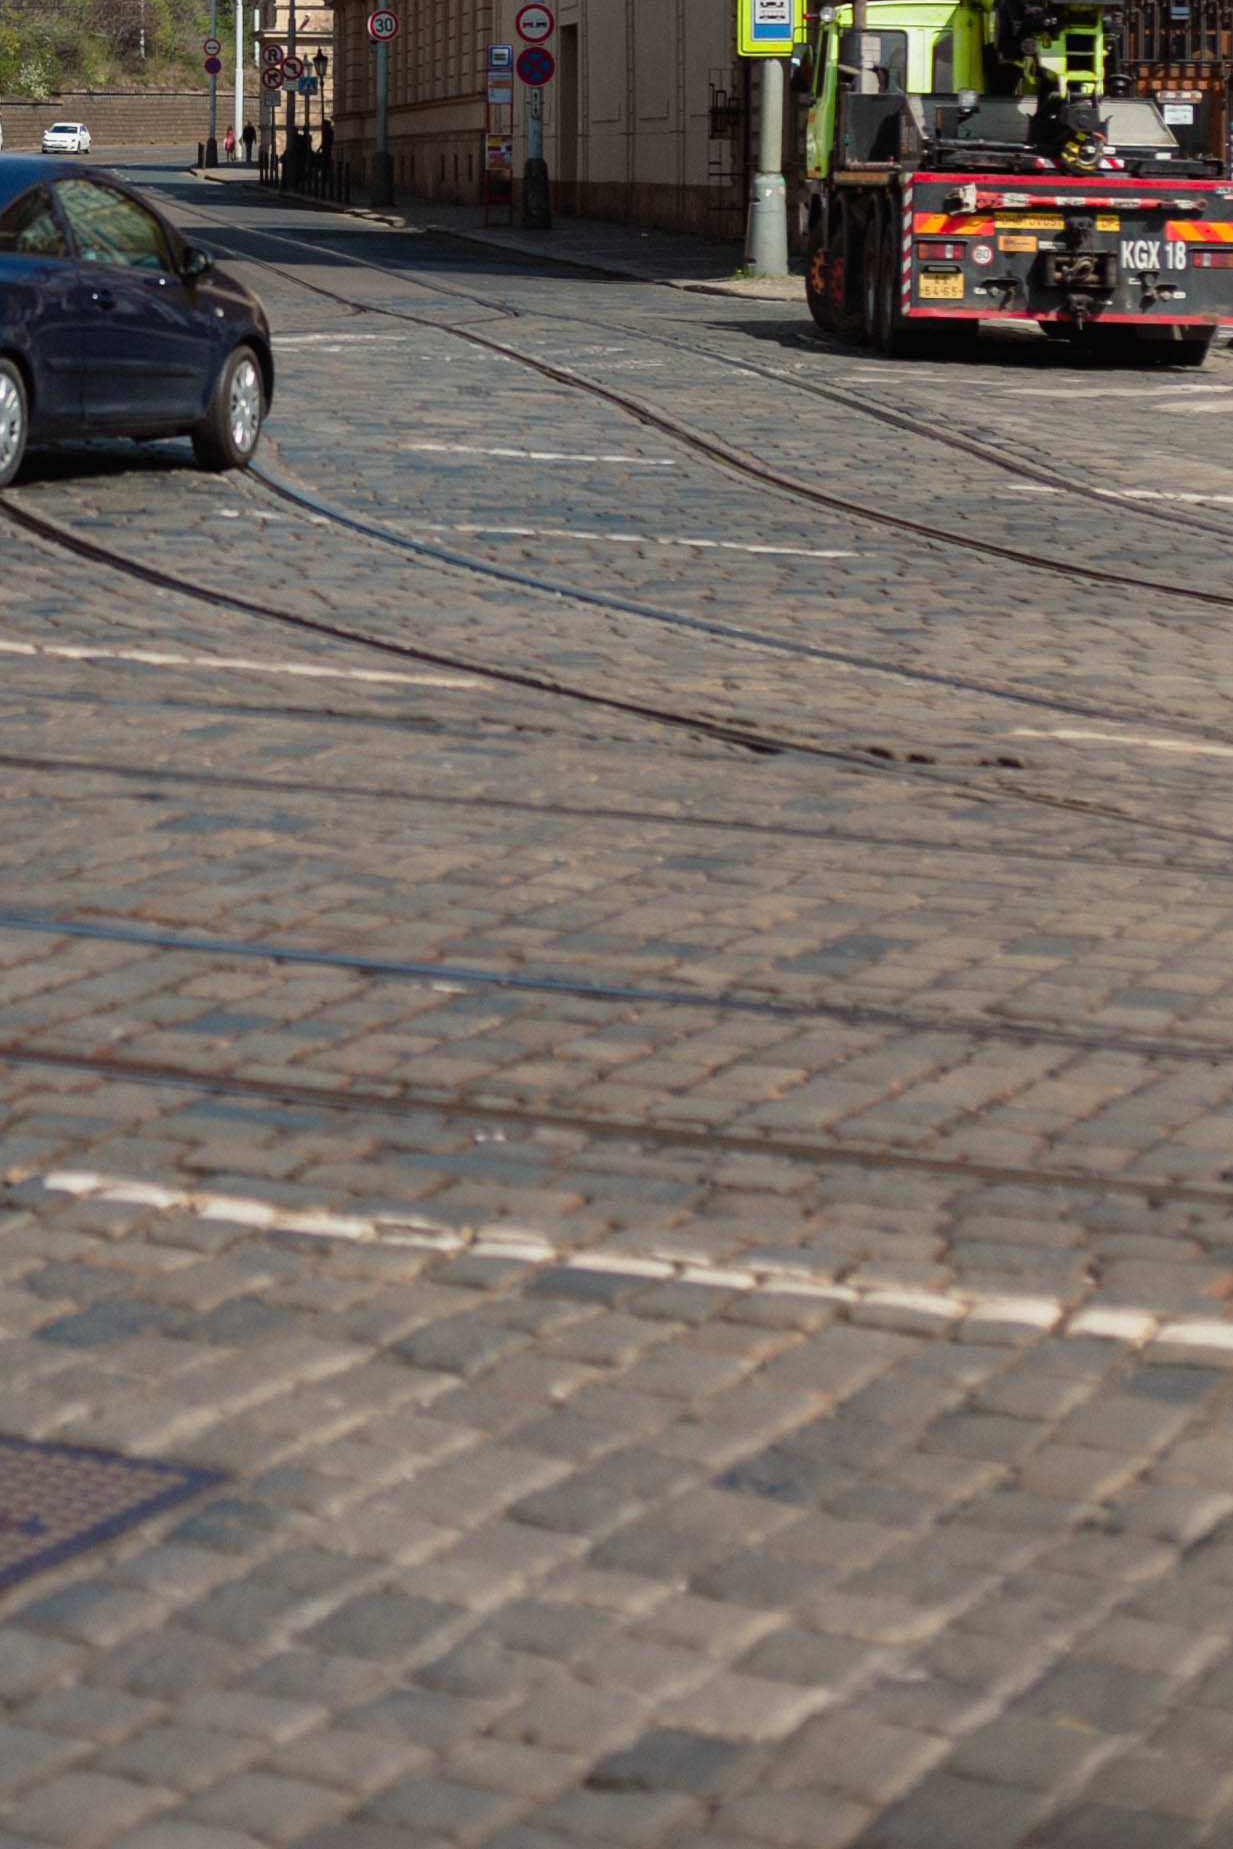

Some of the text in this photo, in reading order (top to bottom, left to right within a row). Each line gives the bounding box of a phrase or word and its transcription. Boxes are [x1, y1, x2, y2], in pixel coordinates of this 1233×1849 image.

[376, 18, 393, 32] 30
[976, 249, 992, 260] 80
[1121, 240, 1186, 270] KGX 18
